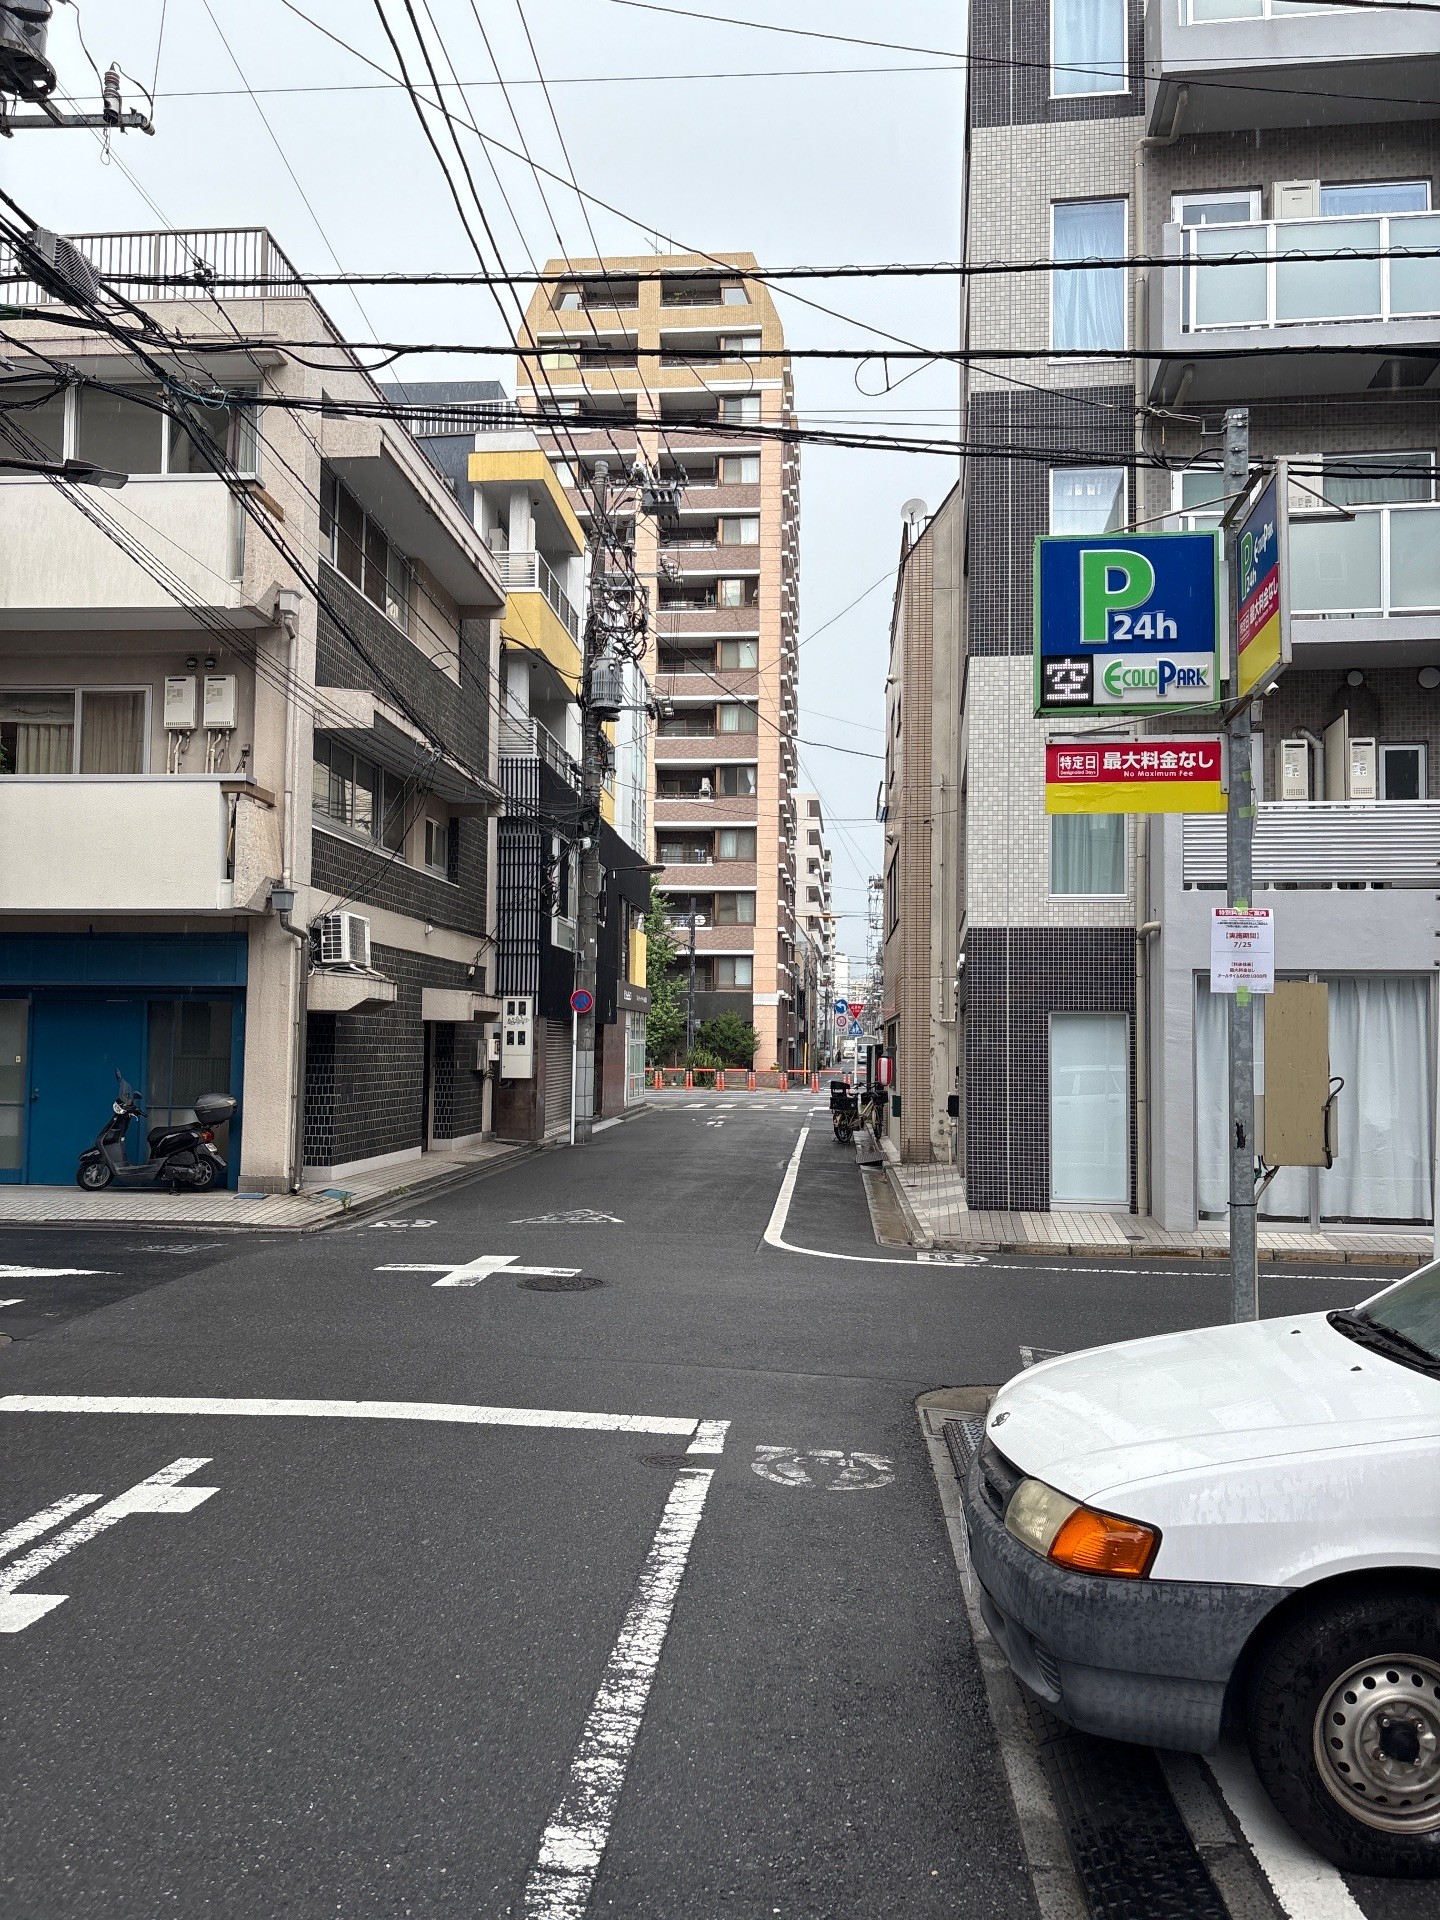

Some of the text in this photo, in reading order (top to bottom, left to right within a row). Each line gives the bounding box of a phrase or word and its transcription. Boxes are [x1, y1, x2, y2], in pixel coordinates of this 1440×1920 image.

[1241, 531, 1253, 602] P
[1080, 549, 1156, 645] P
[1113, 611, 1178, 640] 24h
[1046, 658, 1089, 700] 空
[1059, 755, 1096, 770] 特定日
[1102, 750, 1214, 770] 最大料金なし
[1123, 769, 1194, 778] No Maximum Fee
[1233, 941, 1252, 949] 7/25
